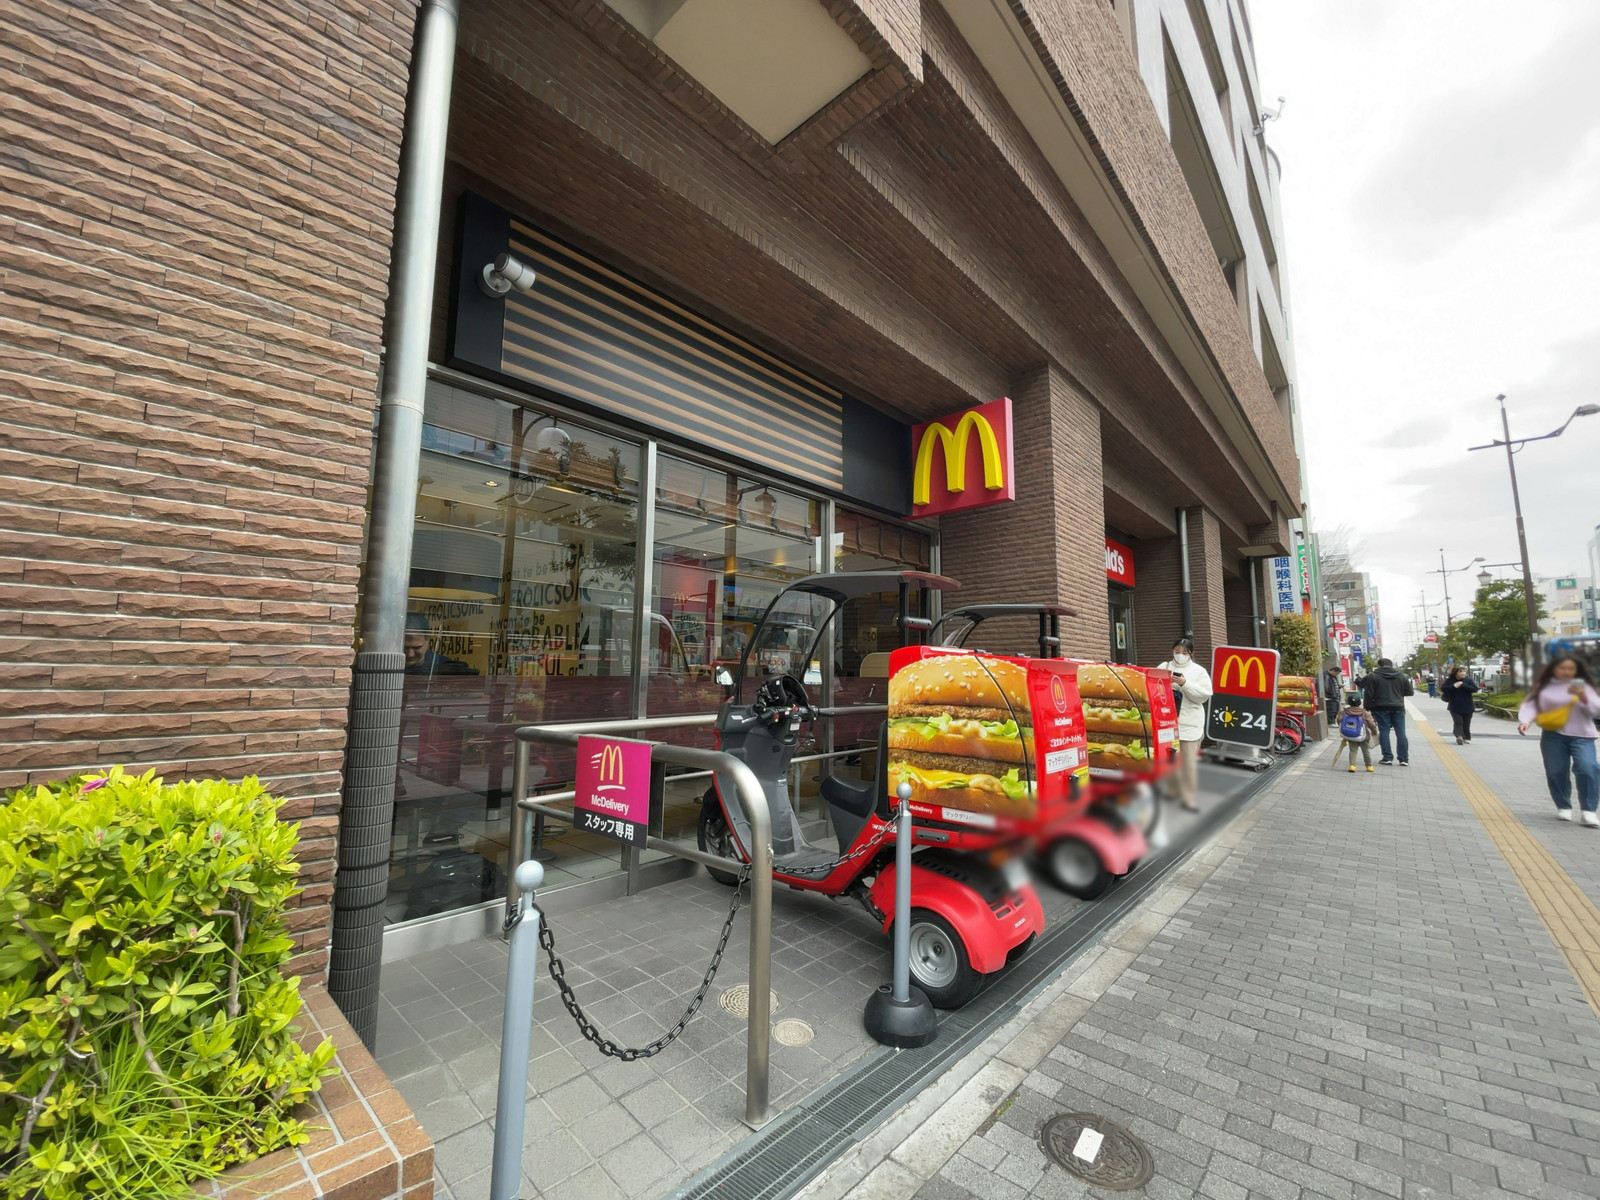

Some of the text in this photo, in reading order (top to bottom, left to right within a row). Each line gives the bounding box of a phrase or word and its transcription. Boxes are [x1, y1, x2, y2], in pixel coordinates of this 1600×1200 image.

[533, 610, 545, 627] be
[1339, 631, 1350, 642] P
[1240, 712, 1268, 731] 24
[591, 794, 630, 816] McDelivery
[585, 813, 635, 841] スタッフ専用
